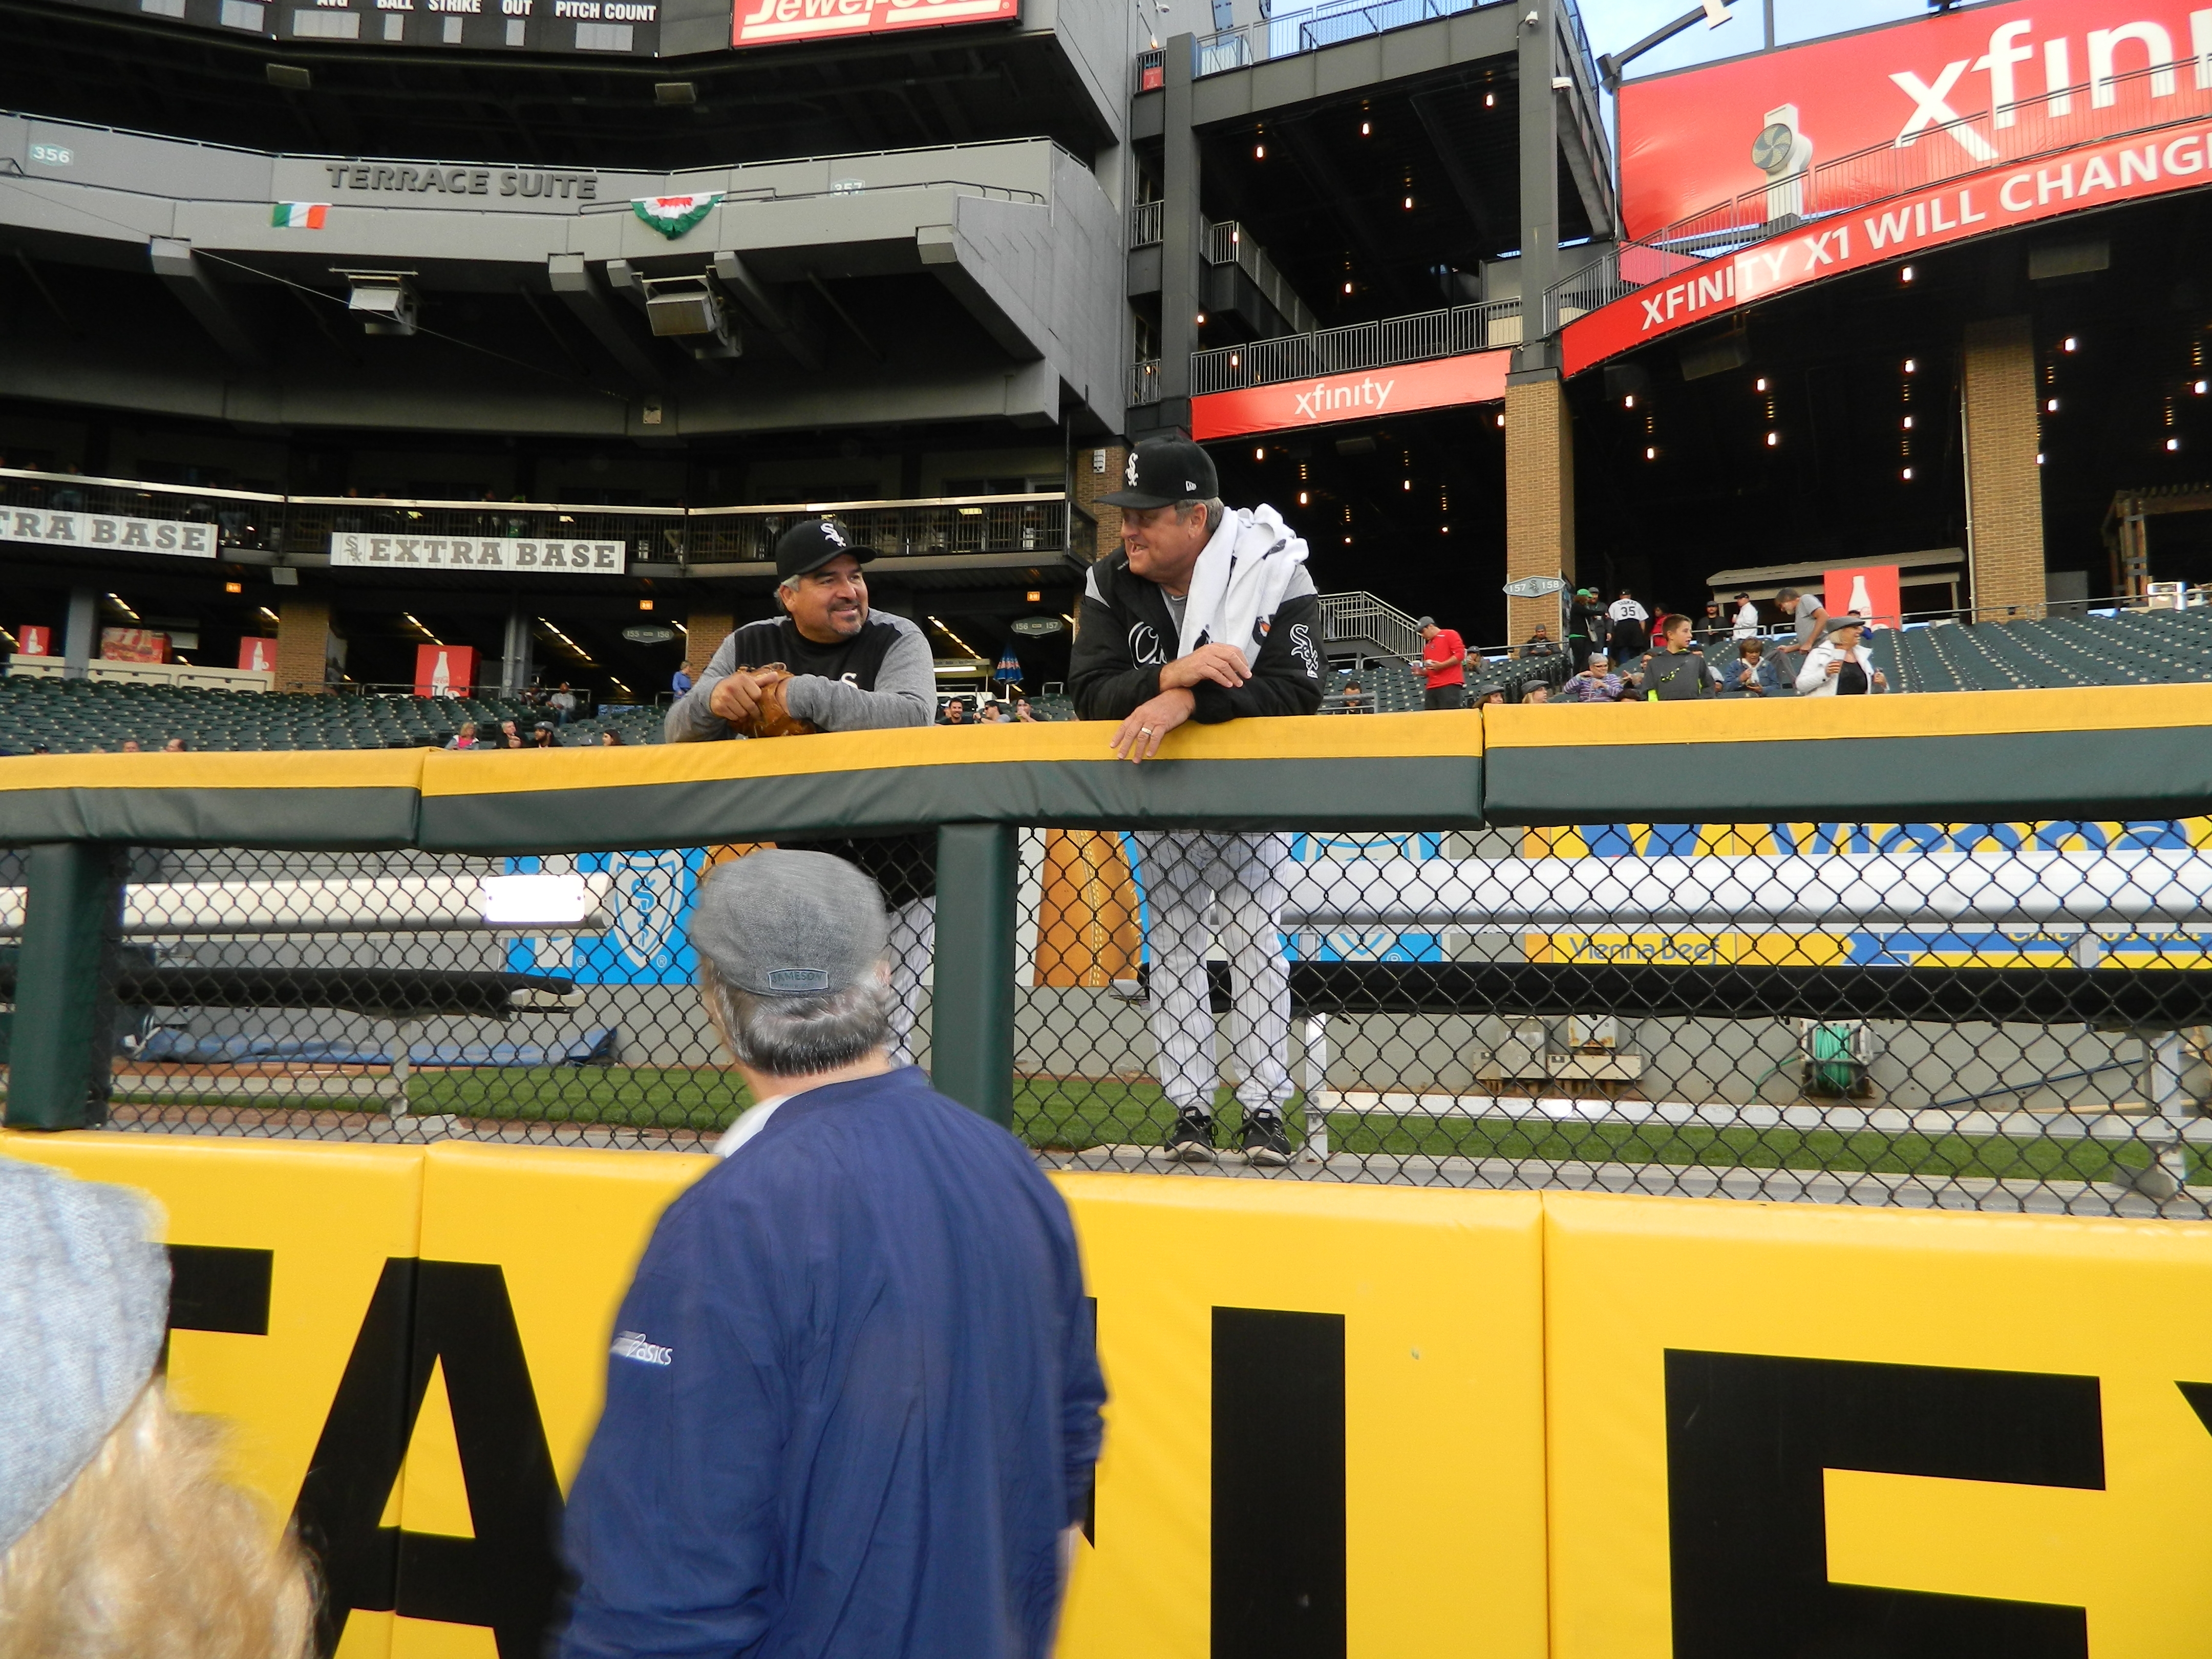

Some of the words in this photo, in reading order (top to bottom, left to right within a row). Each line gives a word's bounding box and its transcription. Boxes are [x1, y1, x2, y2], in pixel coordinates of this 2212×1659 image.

[377, 0, 414, 10] BALL
[428, 0, 481, 14] STRIKE
[502, 0, 534, 16] OUT
[555, 1, 600, 19] PITCH
[604, 3, 657, 22] COUNT
[33, 146, 70, 164] 356
[326, 164, 490, 195] TERRACE
[499, 171, 599, 200] SUITE
[833, 182, 863, 196] 357
[1641, 247, 1789, 331] XFINITY
[1804, 226, 1849, 271] X1
[1864, 189, 1986, 250] WILL
[1999, 132, 2212, 213] CHANG
[1294, 376, 1395, 419] xfinity
[91, 519, 206, 552] BASE
[369, 538, 503, 565] EXTRA
[516, 542, 615, 568] BASE
[1509, 583, 1526, 593] 157
[1541, 580, 1559, 590] 158
[1621, 606, 1636, 617] 35
[1015, 622, 1029, 630] 156
[1046, 621, 1059, 629] 157
[1568, 937, 1656, 960] Vienna
[1661, 937, 1720, 966] Beef
[772, 971, 822, 983] JAMESON
[635, 1341, 673, 1366] asics
